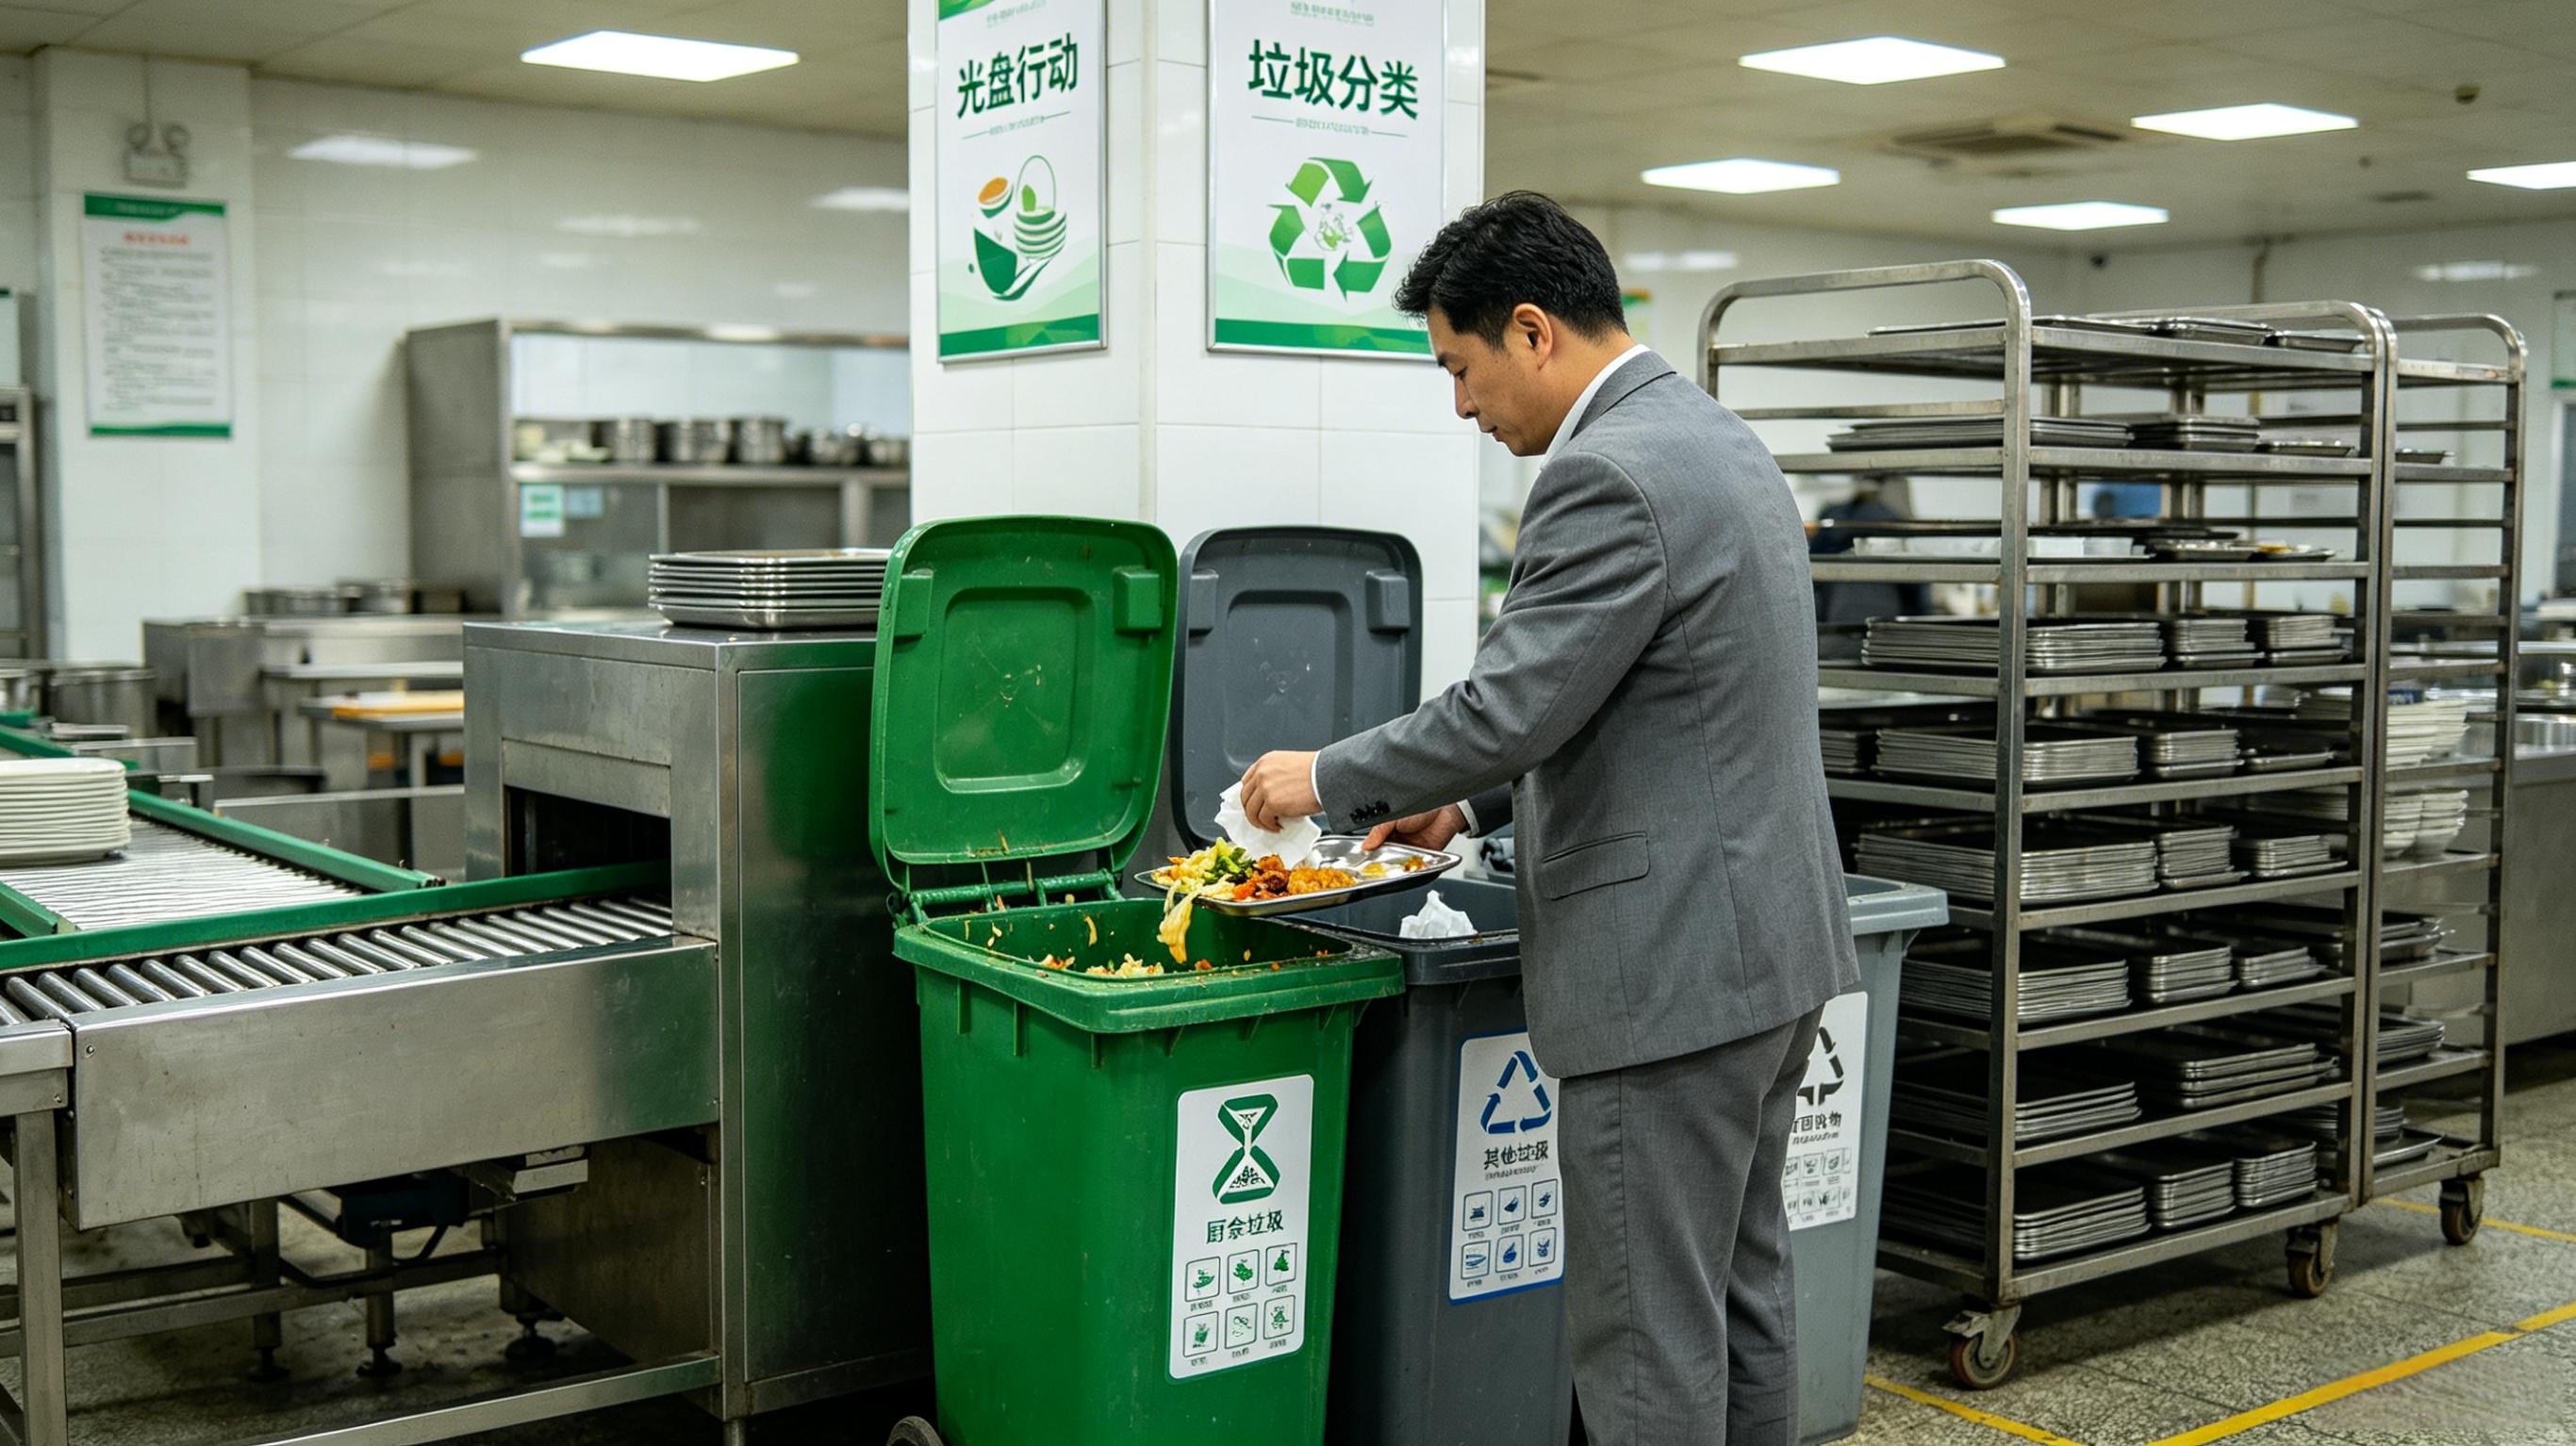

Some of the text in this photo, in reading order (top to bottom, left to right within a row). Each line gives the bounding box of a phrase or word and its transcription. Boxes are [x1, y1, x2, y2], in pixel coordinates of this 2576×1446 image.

[957, 32, 1078, 119] 光盘行动
[1247, 39, 1418, 120] 垃圾分类
